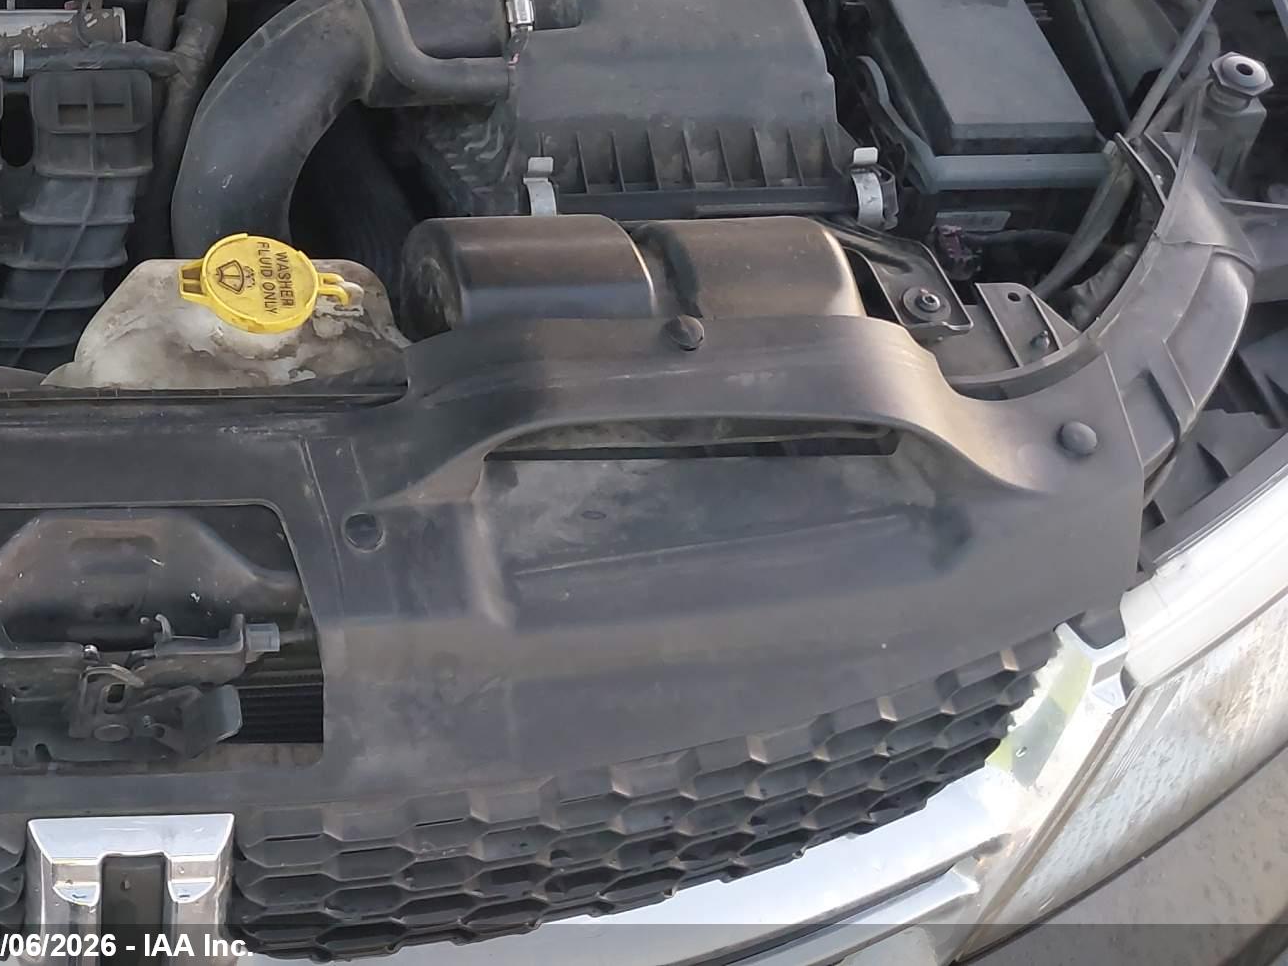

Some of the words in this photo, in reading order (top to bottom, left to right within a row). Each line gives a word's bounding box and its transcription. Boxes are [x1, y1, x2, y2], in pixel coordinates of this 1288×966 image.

[257, 241, 273, 278] FLUID
[262, 281, 280, 314] ONLY
[275, 251, 296, 307] WASHER
